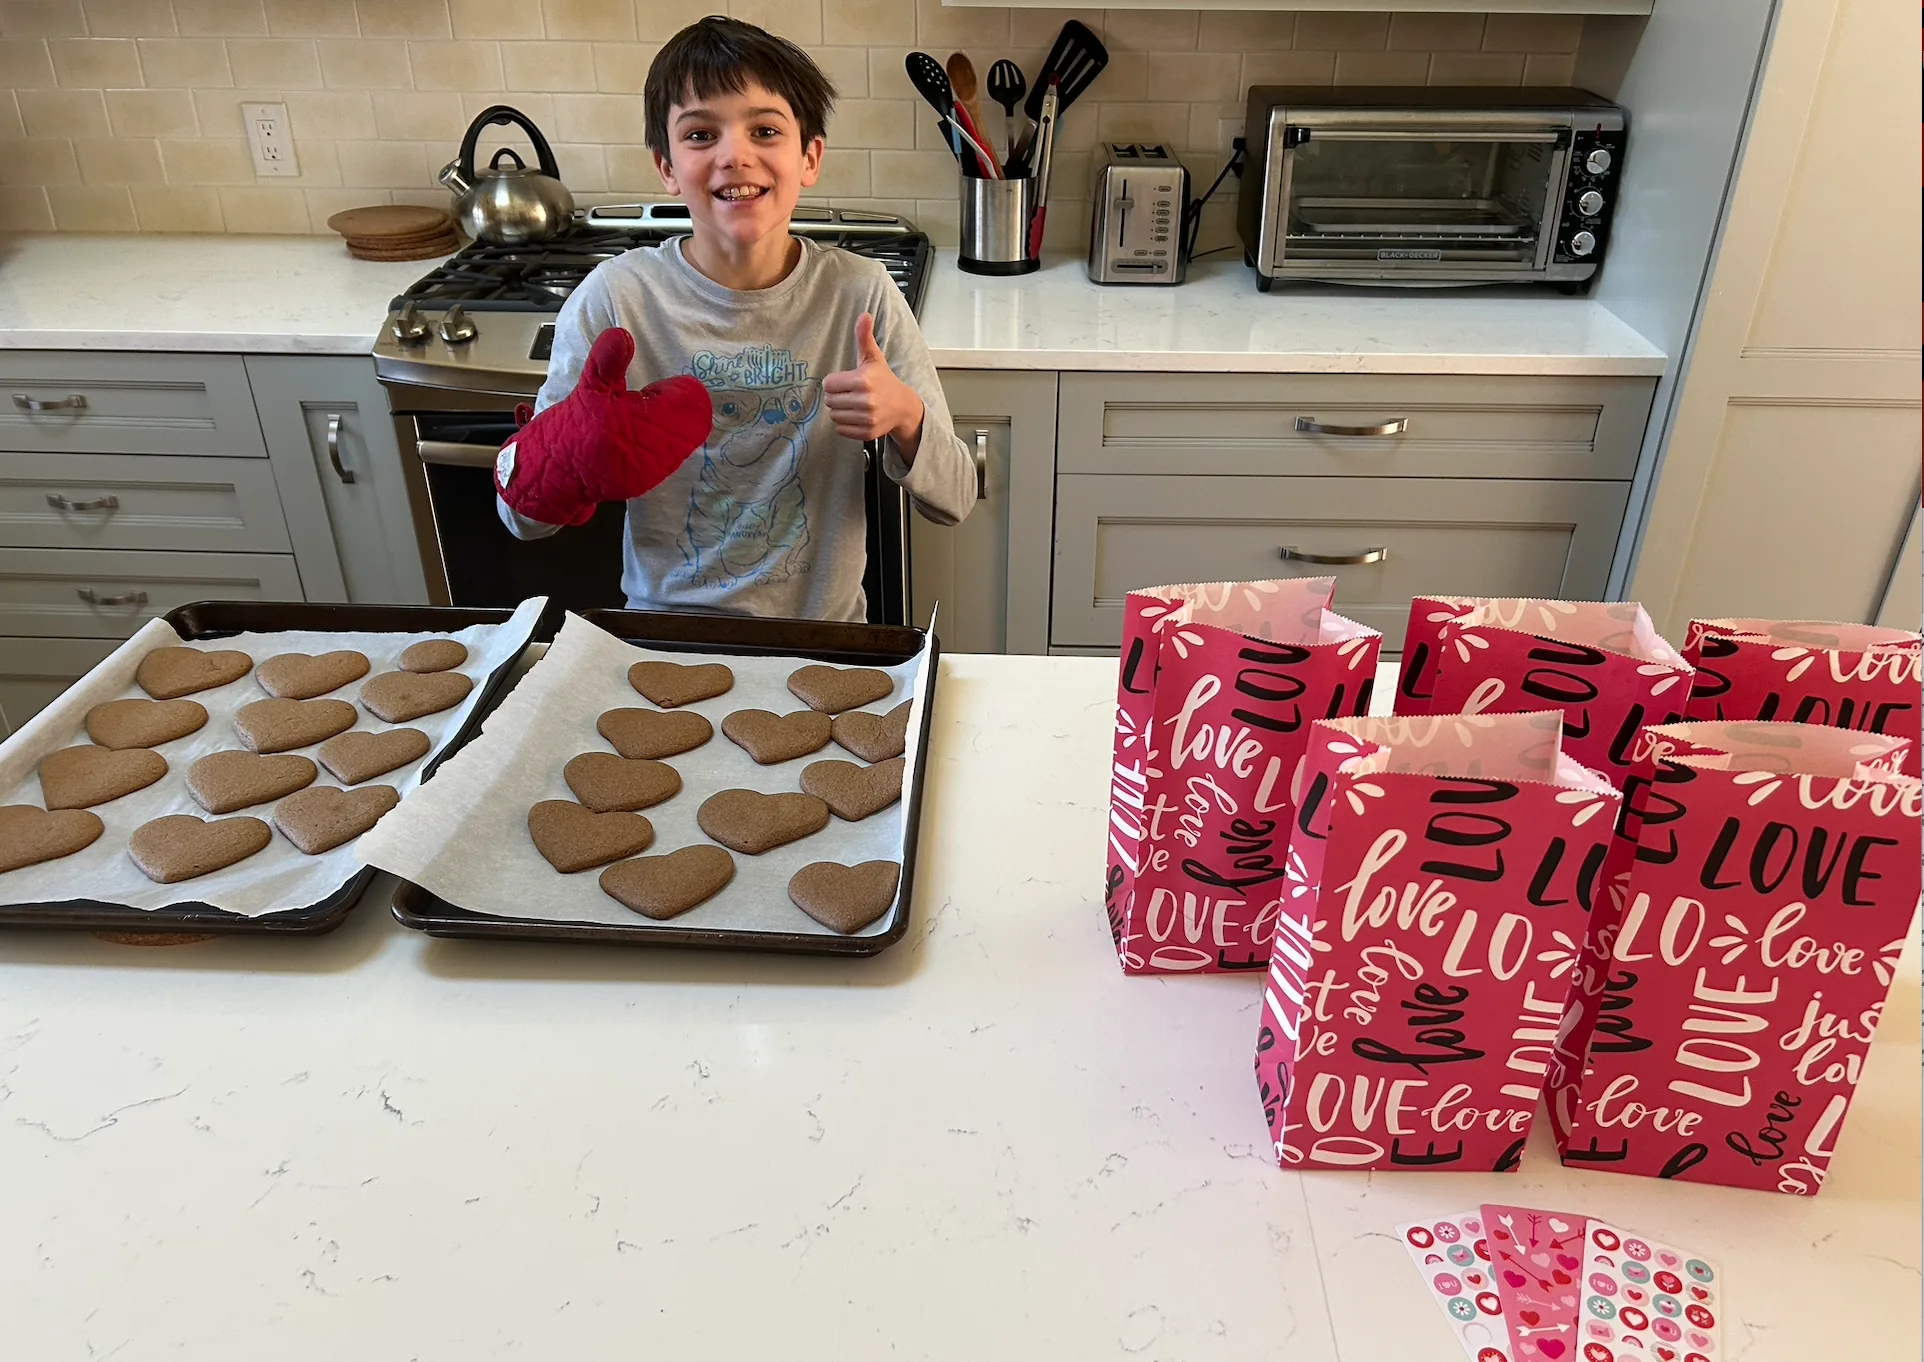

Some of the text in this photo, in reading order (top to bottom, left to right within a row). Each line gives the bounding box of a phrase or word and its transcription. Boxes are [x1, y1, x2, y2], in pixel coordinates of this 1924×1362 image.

[1380, 251, 1439, 259] BLACK+DECKER
[696, 354, 745, 380] Shine
[744, 361, 805, 386] BRIGHT
[1163, 674, 1263, 778] love
[1333, 829, 1457, 942] love
[1700, 817, 1899, 906] LOVE
[1442, 910, 1533, 981] LO
[1613, 892, 1706, 967] LO
[1755, 902, 1865, 975] love
[1343, 938, 1424, 1026] love
[1668, 967, 1779, 1107] LOVE
[1779, 991, 1887, 1051] jus
[1421, 1083, 1533, 1133] love
[1586, 1074, 1703, 1137] love
[1725, 1090, 1802, 1166] love
